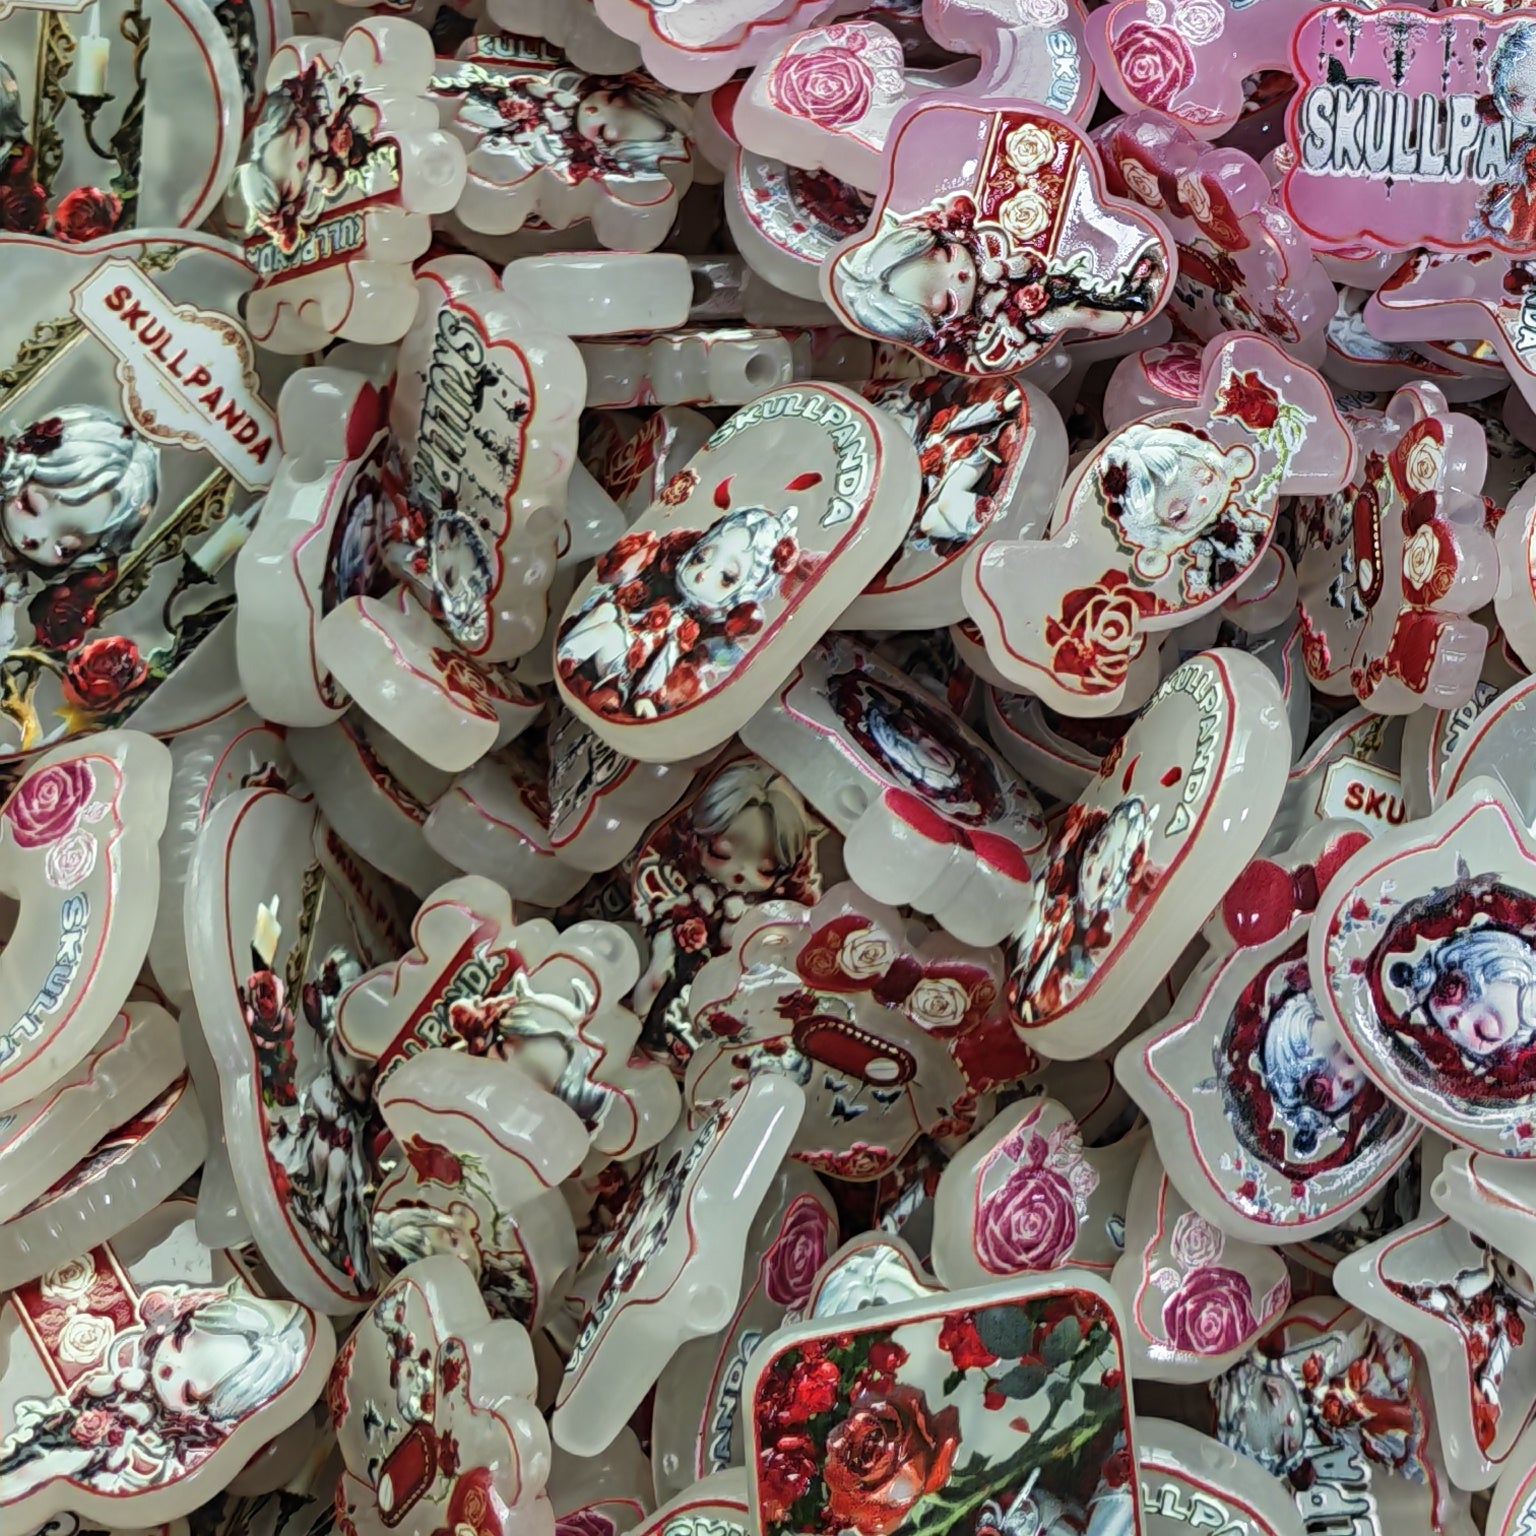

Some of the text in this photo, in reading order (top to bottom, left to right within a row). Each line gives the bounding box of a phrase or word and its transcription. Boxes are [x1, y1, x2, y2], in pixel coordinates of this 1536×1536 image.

[104, 286, 273, 464] SKULLPANDA
[708, 394, 868, 528] SKULLPANDA
[1142, 663, 1221, 837] SKULLPANDA
